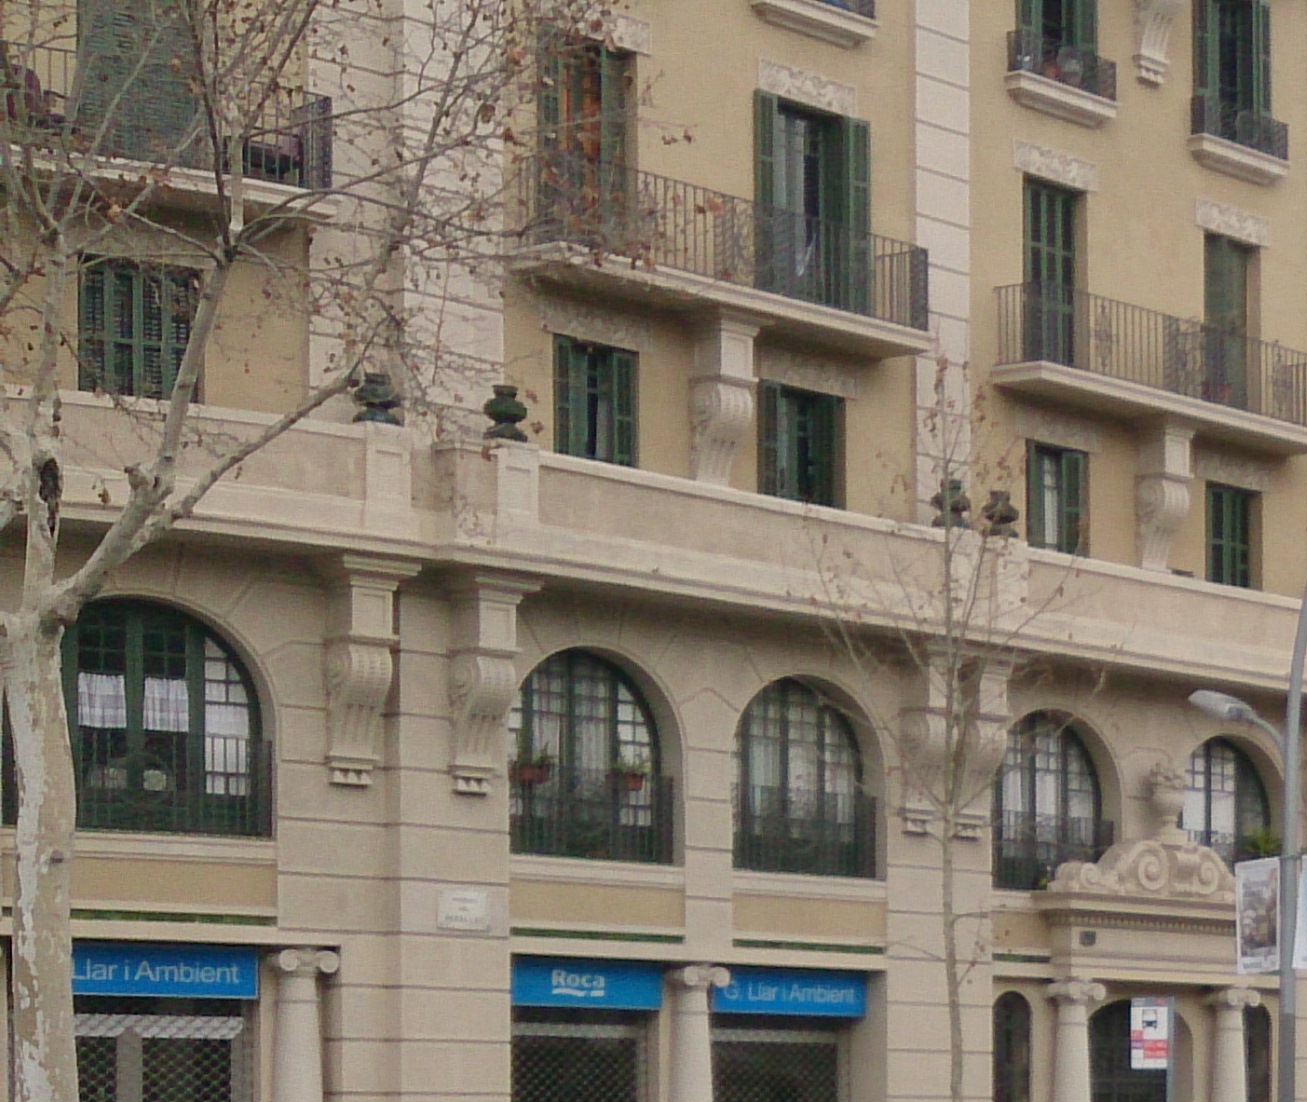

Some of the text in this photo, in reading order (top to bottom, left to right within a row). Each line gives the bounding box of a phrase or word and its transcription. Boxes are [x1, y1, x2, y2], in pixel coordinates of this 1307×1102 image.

[72, 958, 117, 980] Llar
[134, 960, 240, 984] Ambient
[552, 969, 605, 988] Roca
[748, 981, 778, 1001] Llar
[790, 983, 855, 1004] Ambient
